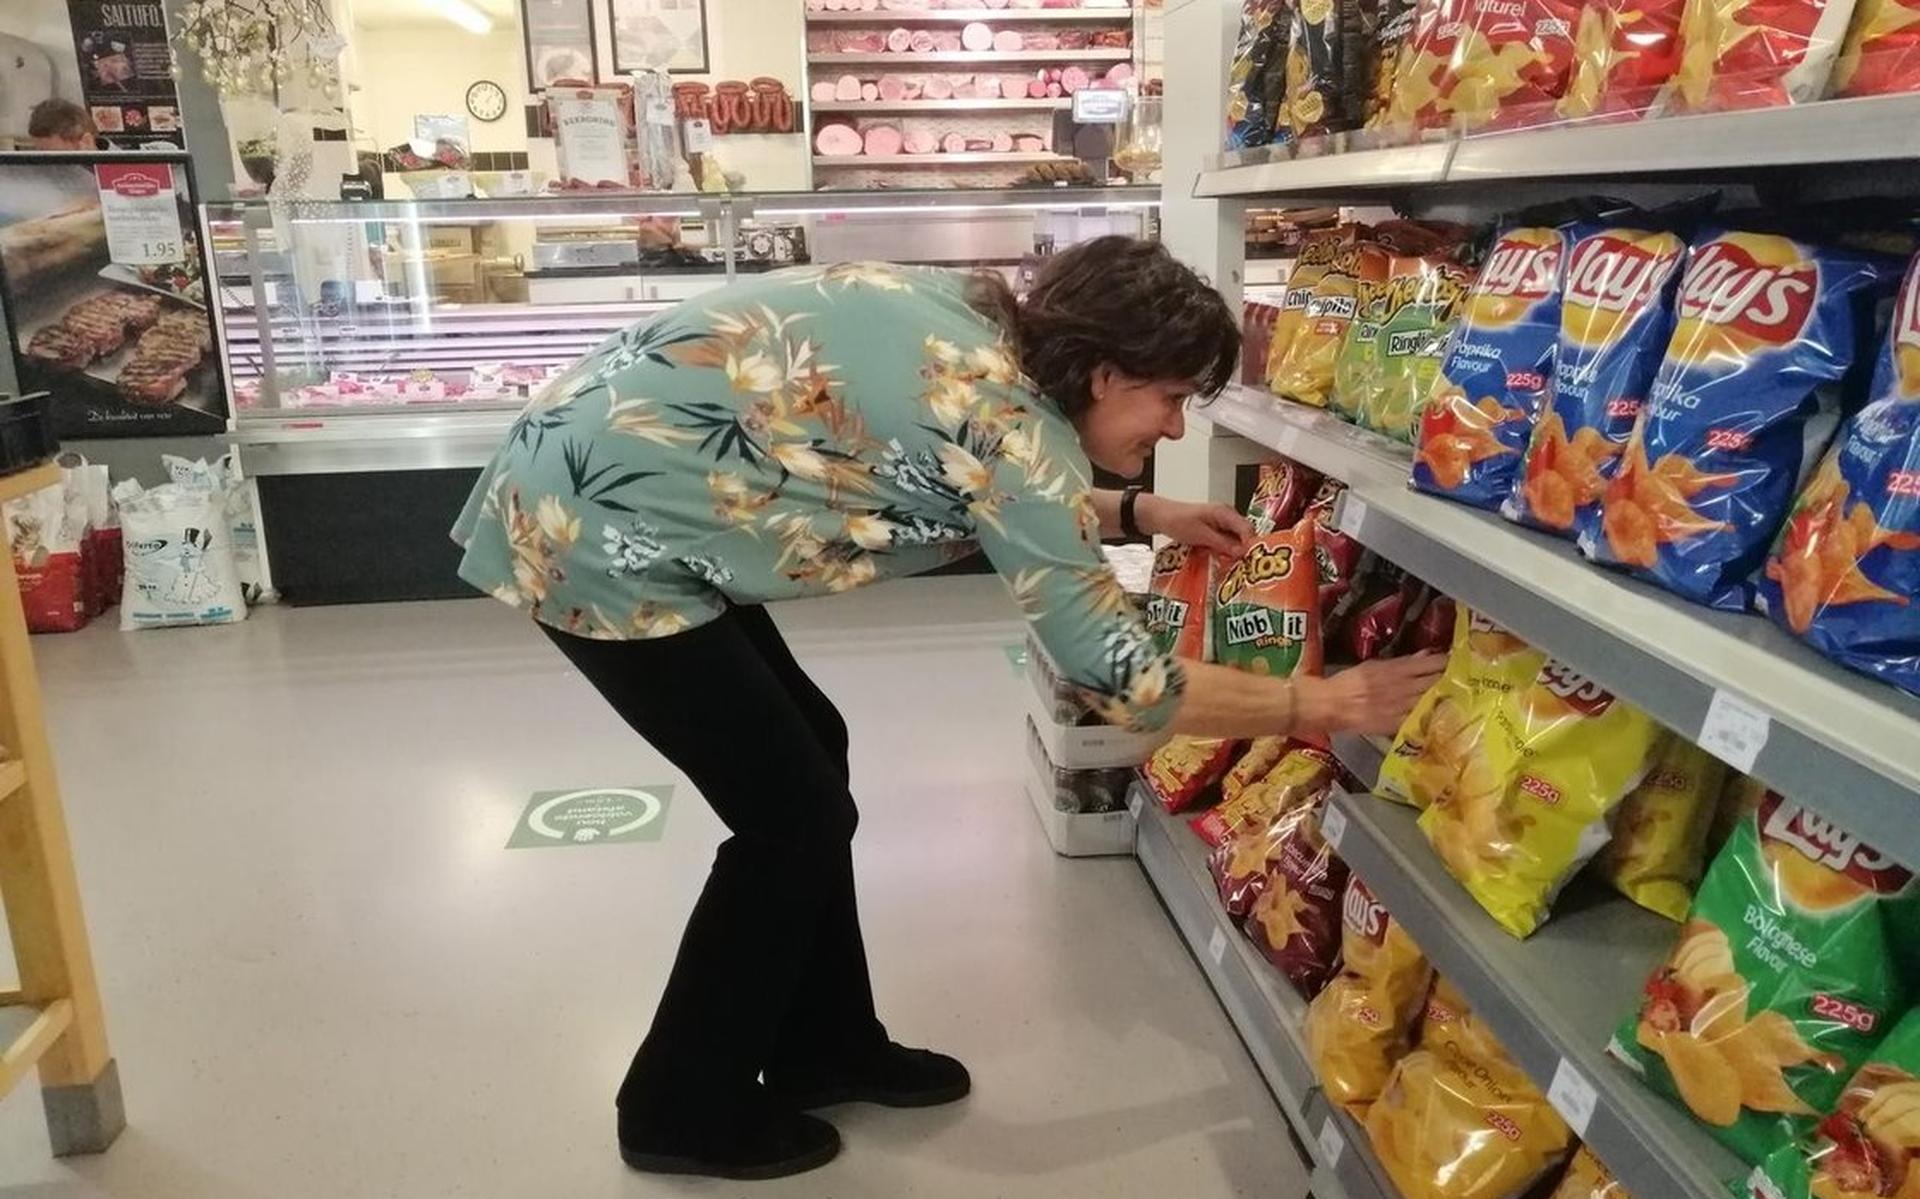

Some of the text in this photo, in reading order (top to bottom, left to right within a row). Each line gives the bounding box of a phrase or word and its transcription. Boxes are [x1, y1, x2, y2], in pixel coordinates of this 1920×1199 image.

[143, 242, 177, 258] 1.95
[1681, 246, 1810, 325] Lay's
[1506, 372, 1542, 390] 225g
[1230, 615, 1303, 640] Nibb it
[1521, 776, 1560, 804] 225g
[1743, 903, 1817, 968] Bolognese
[1812, 995, 1875, 1031] 225g
[1487, 1111, 1521, 1141] 225g
